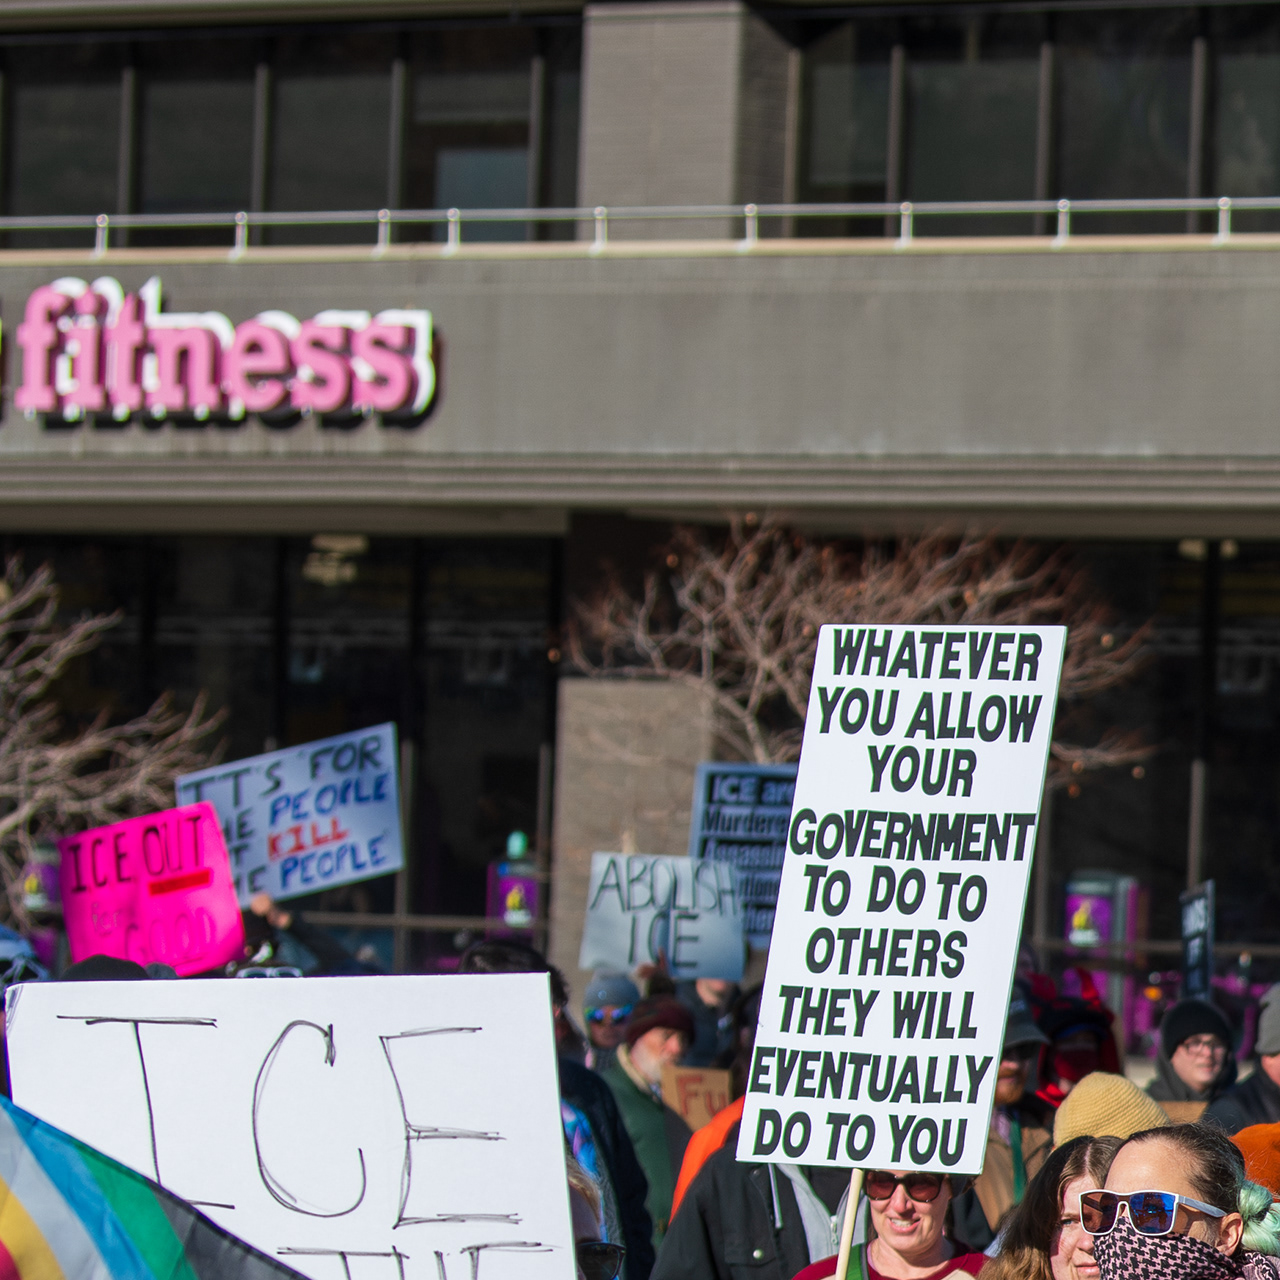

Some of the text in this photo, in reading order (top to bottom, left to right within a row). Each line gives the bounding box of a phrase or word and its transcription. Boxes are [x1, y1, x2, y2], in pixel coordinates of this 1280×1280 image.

[15, 276, 434, 413] fitness
[833, 628, 1043, 681] WHATEVER
[817, 686, 1043, 744] YOU ALLOW
[310, 735, 385, 781] FOR
[867, 744, 977, 798] YOUR
[270, 773, 389, 827] PEOPLE
[710, 775, 760, 802] ICE
[68, 816, 203, 893] ICE OUT
[268, 816, 350, 861] KILL
[280, 834, 386, 891] PEOPLE
[790, 808, 1037, 862] GOVERNMENT
[589, 856, 739, 916] ABOLISH
[804, 864, 851, 917] TO
[867, 865, 926, 916] DO
[936, 872, 988, 922] TO
[628, 911, 700, 970] ICE
[805, 926, 968, 979] OTHERS
[779, 984, 978, 1040] THEY WILL
[749, 1046, 993, 1104] EVENTUALLY
[56, 1015, 522, 1228] ICE
[752, 1108, 968, 1167] DO TO YOU
